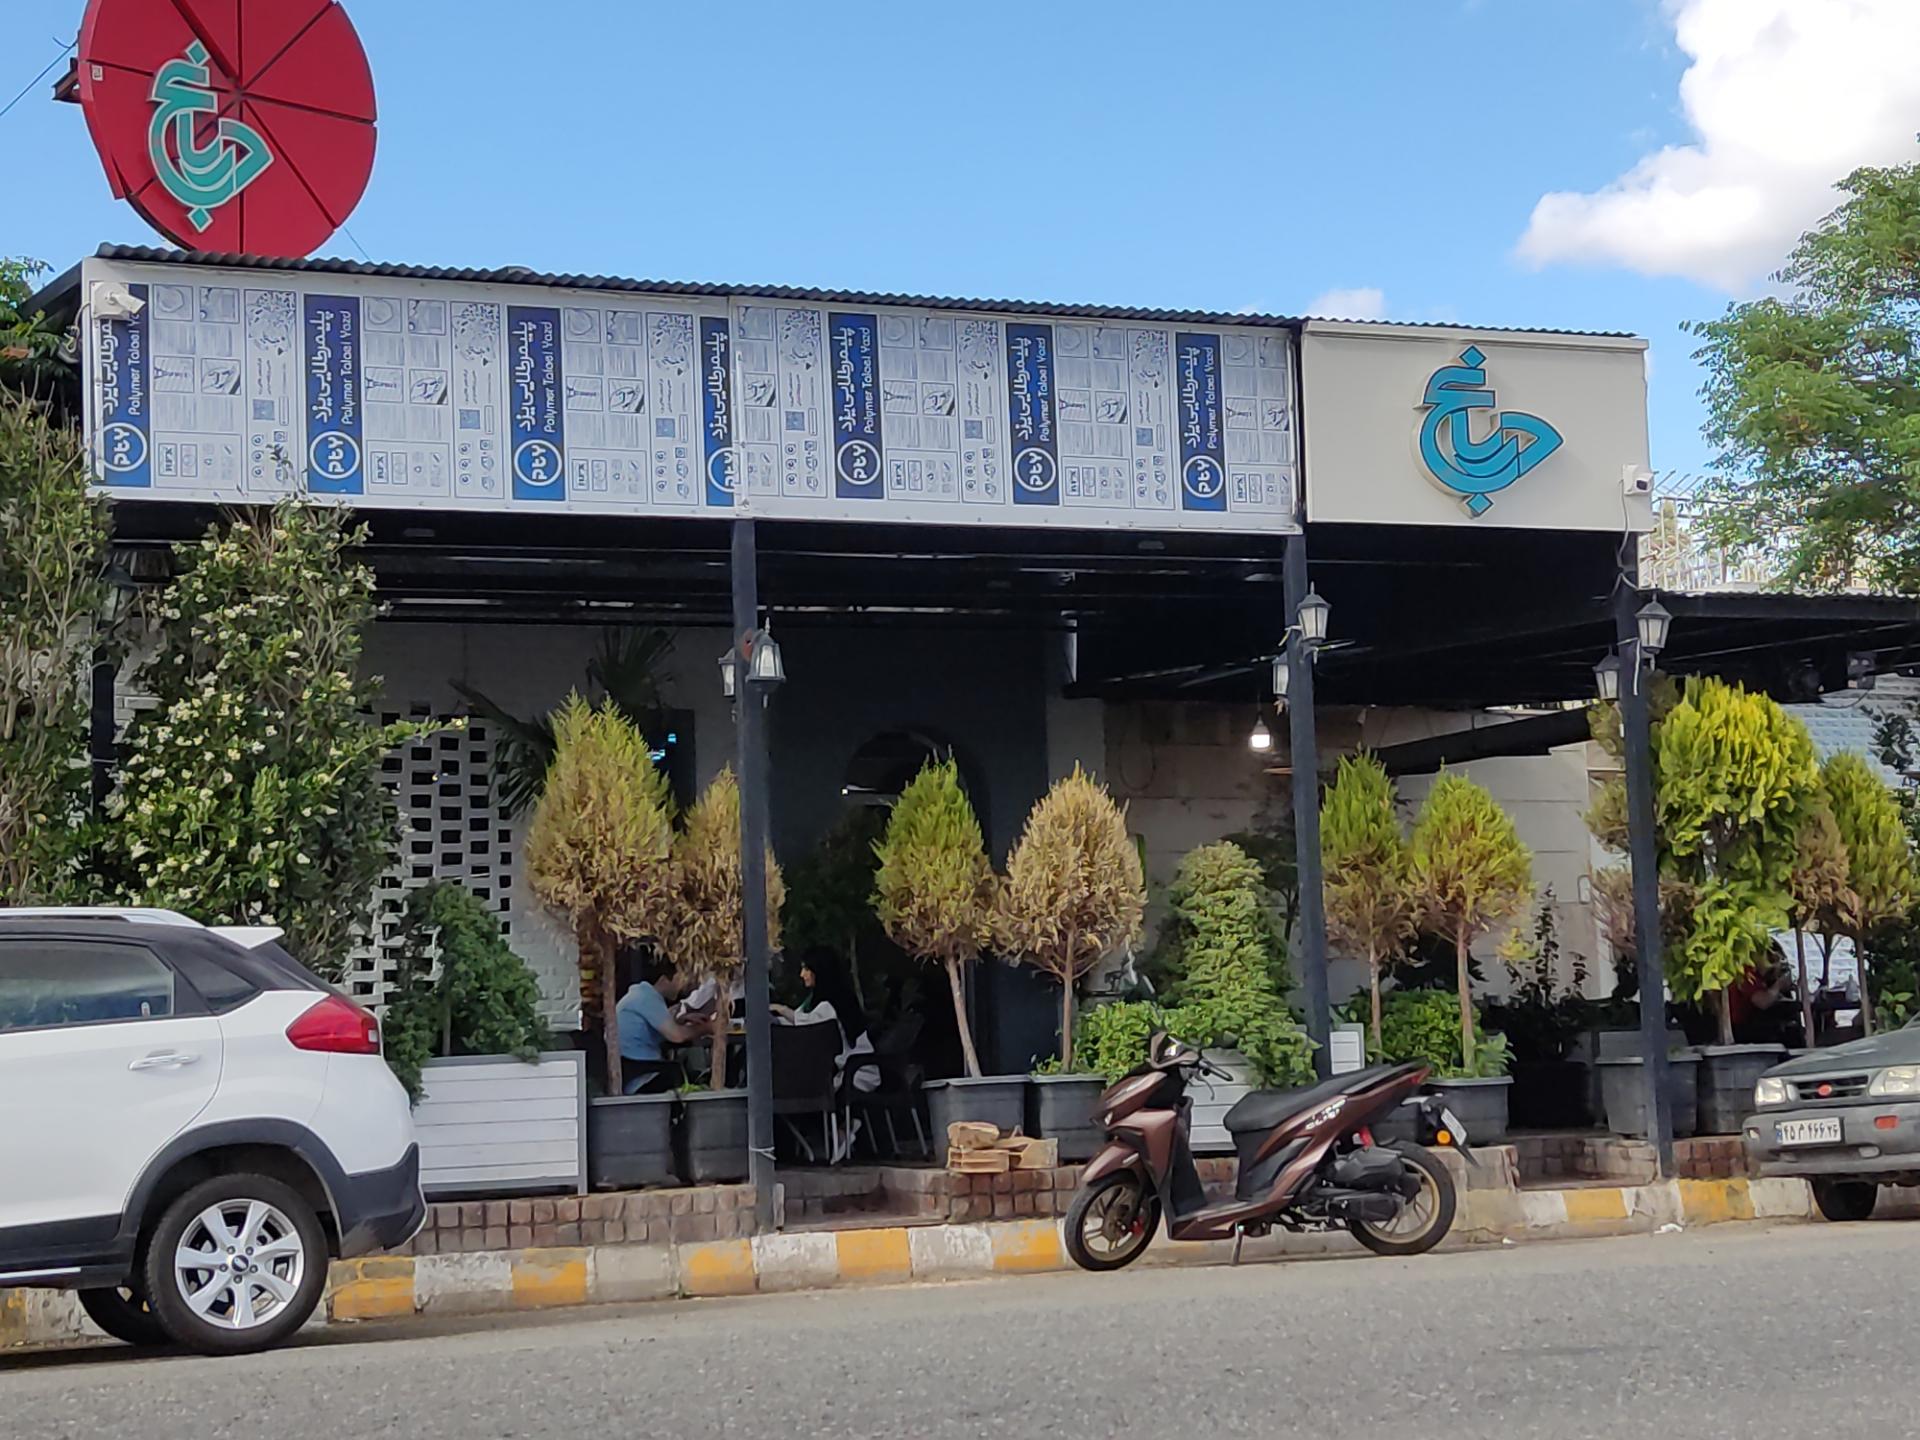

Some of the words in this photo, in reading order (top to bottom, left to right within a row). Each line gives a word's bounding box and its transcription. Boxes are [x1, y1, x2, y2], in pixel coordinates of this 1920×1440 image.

[339, 310, 352, 339] Yazd
[540, 321, 553, 348] Yazd
[858, 327, 870, 353] Yazd
[1035, 337, 1047, 362] Yazd
[1202, 347, 1214, 372] Yazd
[127, 368, 143, 416] Polymer
[341, 379, 356, 425] Polymer
[543, 388, 558, 433] Polymer
[863, 390, 877, 434] Polymer
[1038, 399, 1051, 442] Polymer
[1206, 408, 1219, 449] Polymer
